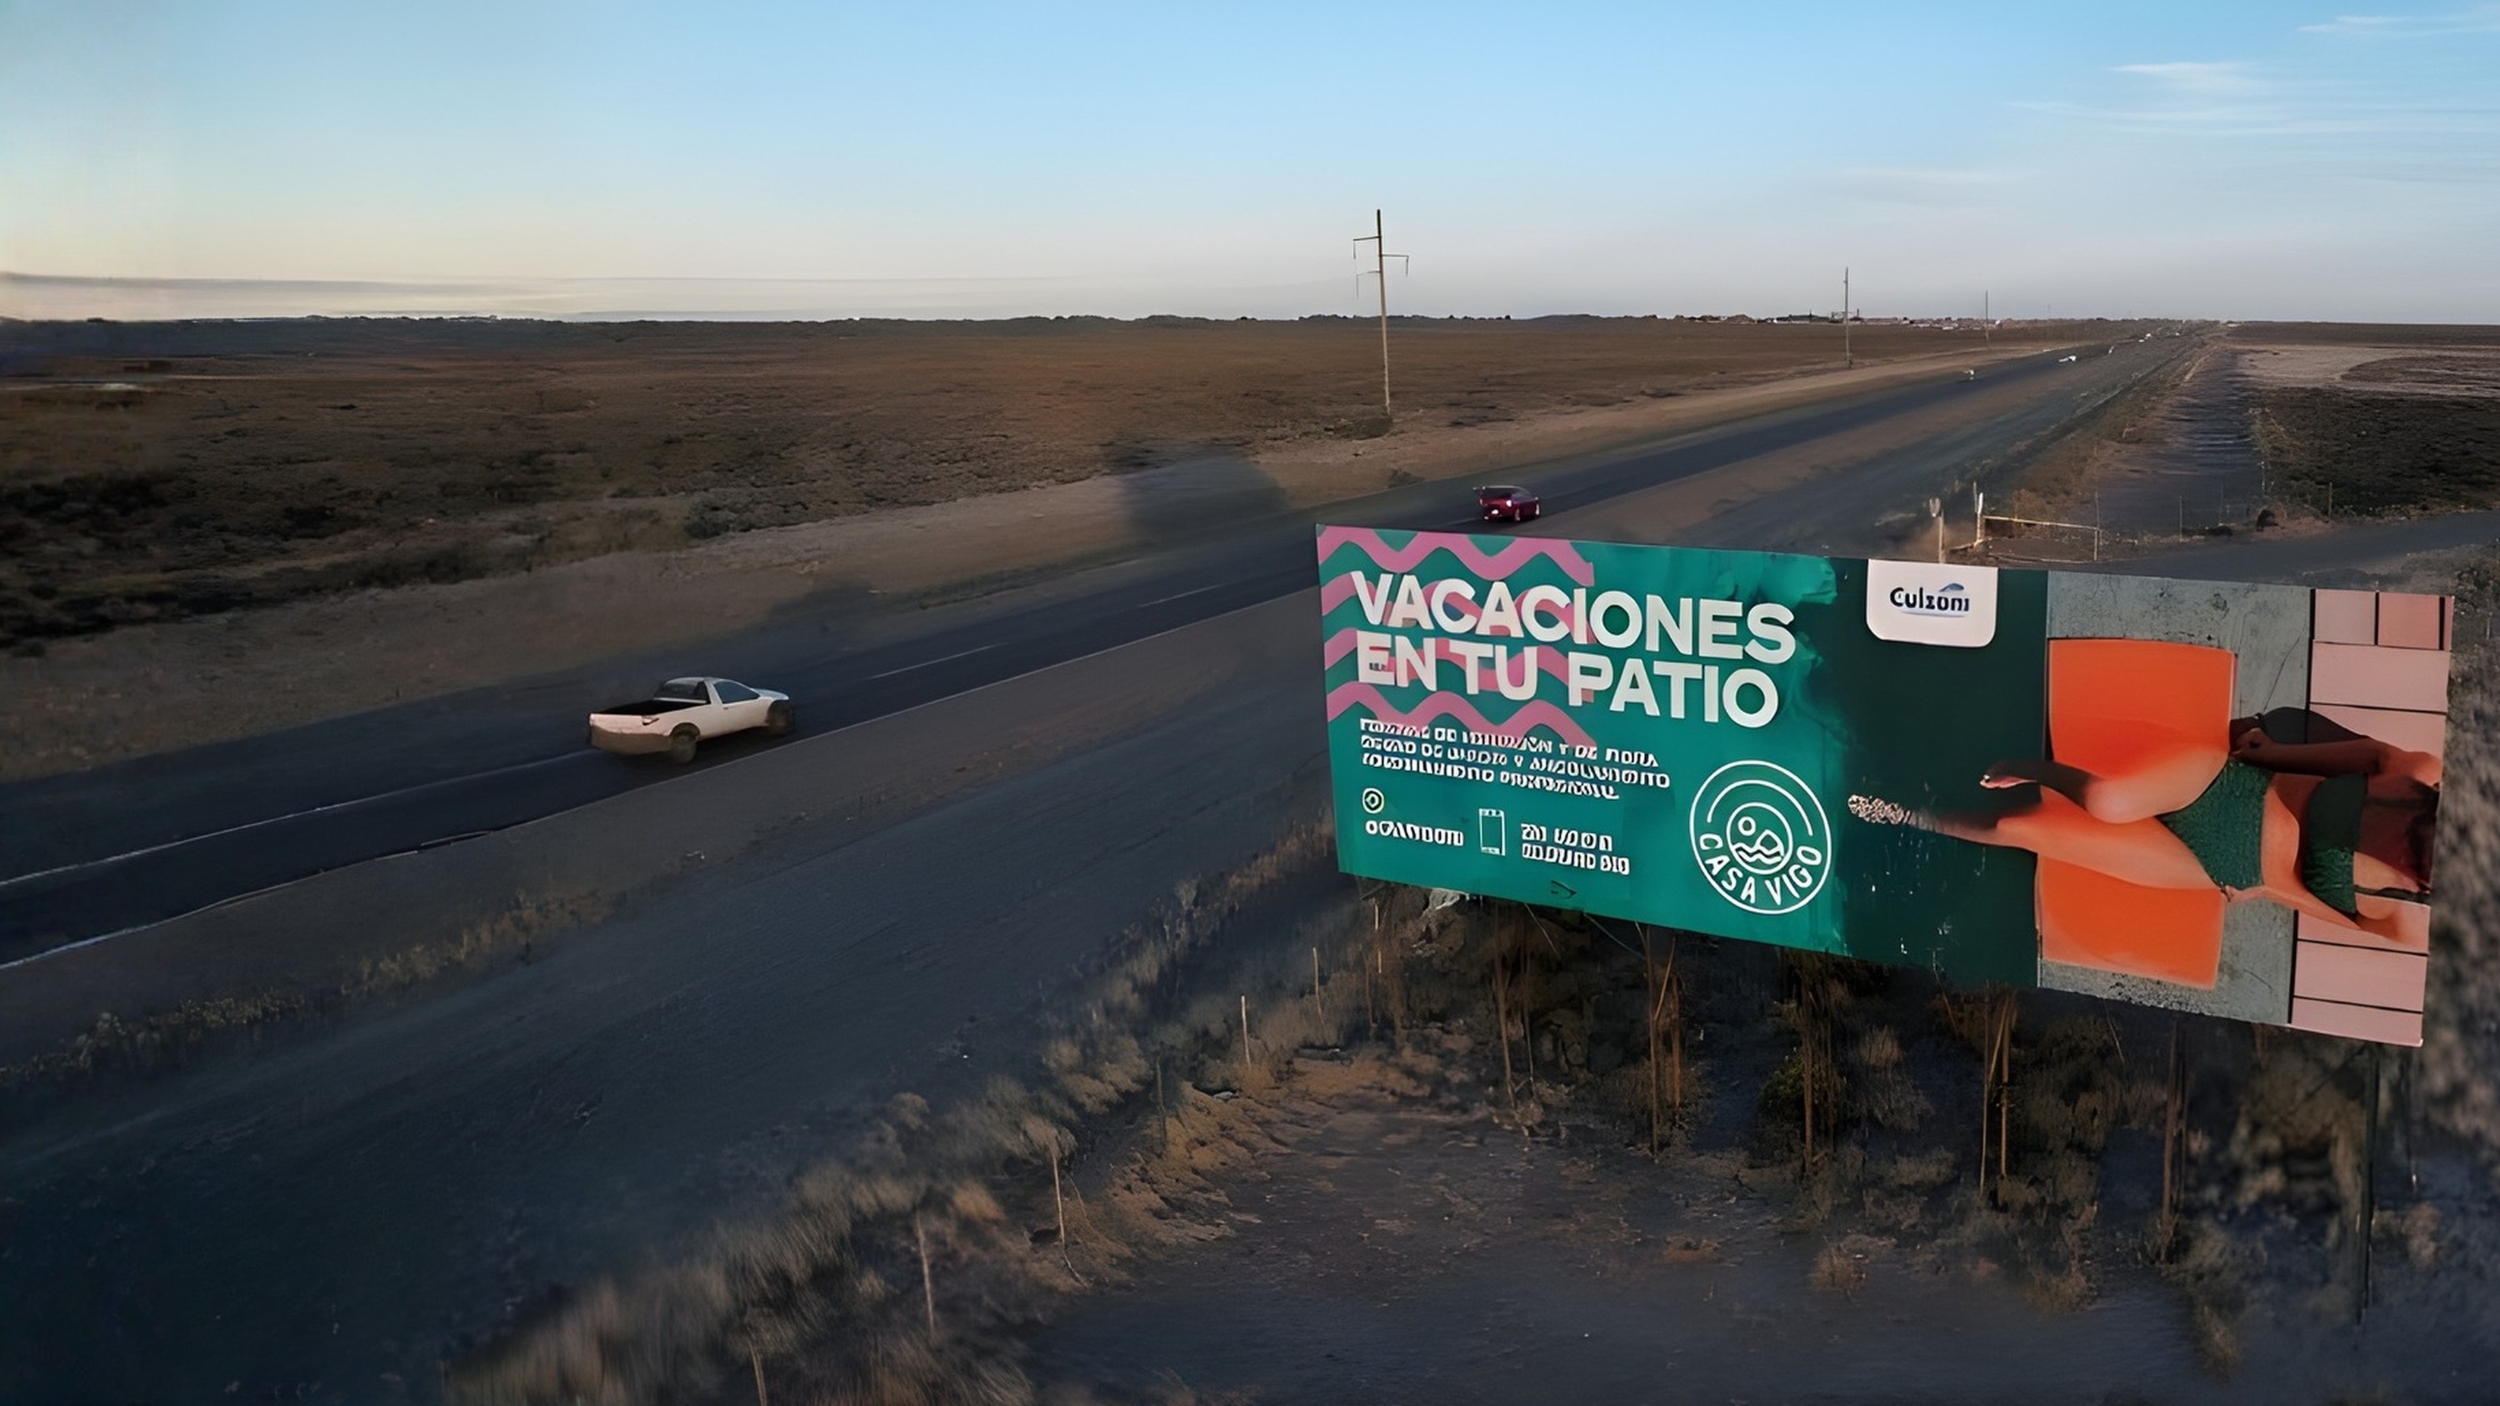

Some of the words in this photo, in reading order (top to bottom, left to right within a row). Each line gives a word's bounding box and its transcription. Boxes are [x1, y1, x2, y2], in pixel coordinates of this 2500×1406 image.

[1351, 570, 1797, 664] VACACIONES
[1356, 630, 1437, 692] EN
[1449, 639, 1538, 701] TU
[1567, 651, 1779, 729] PATIO
[1699, 833, 1757, 905] CASA
[1763, 845, 1823, 906] VIGO
